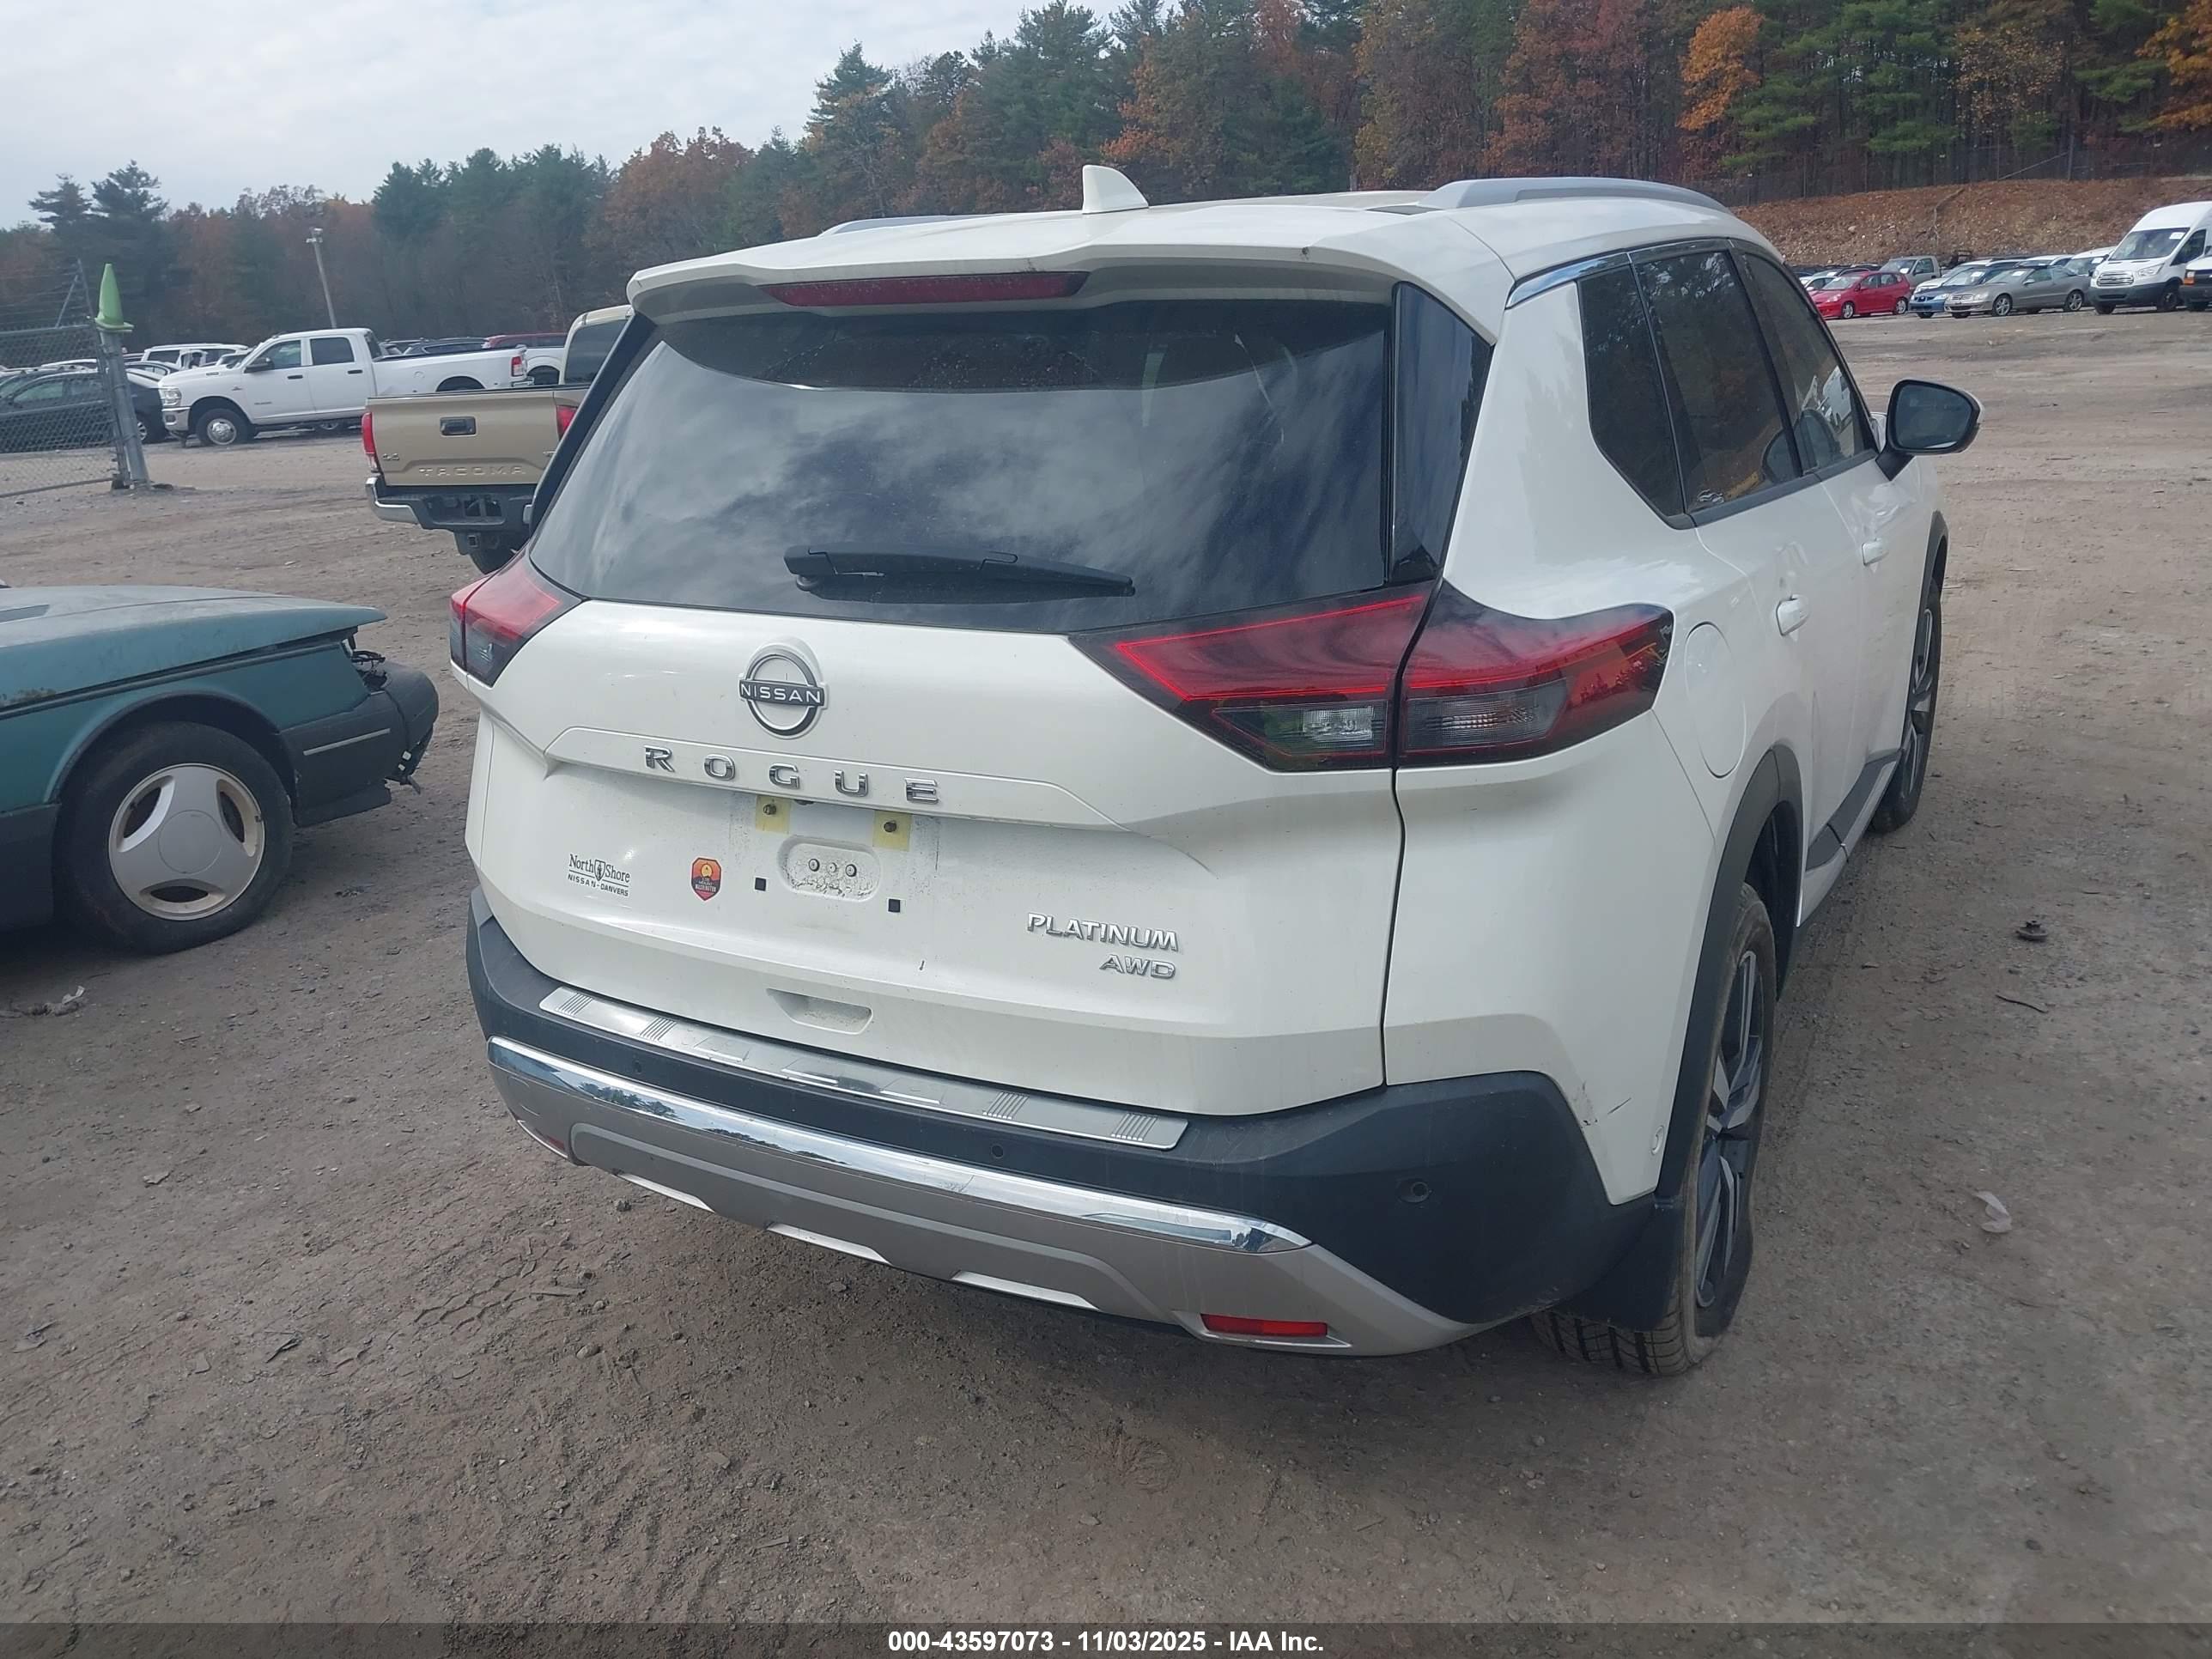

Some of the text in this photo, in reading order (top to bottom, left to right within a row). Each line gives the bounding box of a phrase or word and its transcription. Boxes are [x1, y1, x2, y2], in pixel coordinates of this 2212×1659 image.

[418, 466, 526, 477] TACOMA
[740, 684, 822, 703] NISSAN
[644, 744, 939, 805] ROGUE
[568, 854, 630, 883] North Shore
[1027, 912, 1179, 952] PLATINUM
[1099, 954, 1176, 979] AWD
